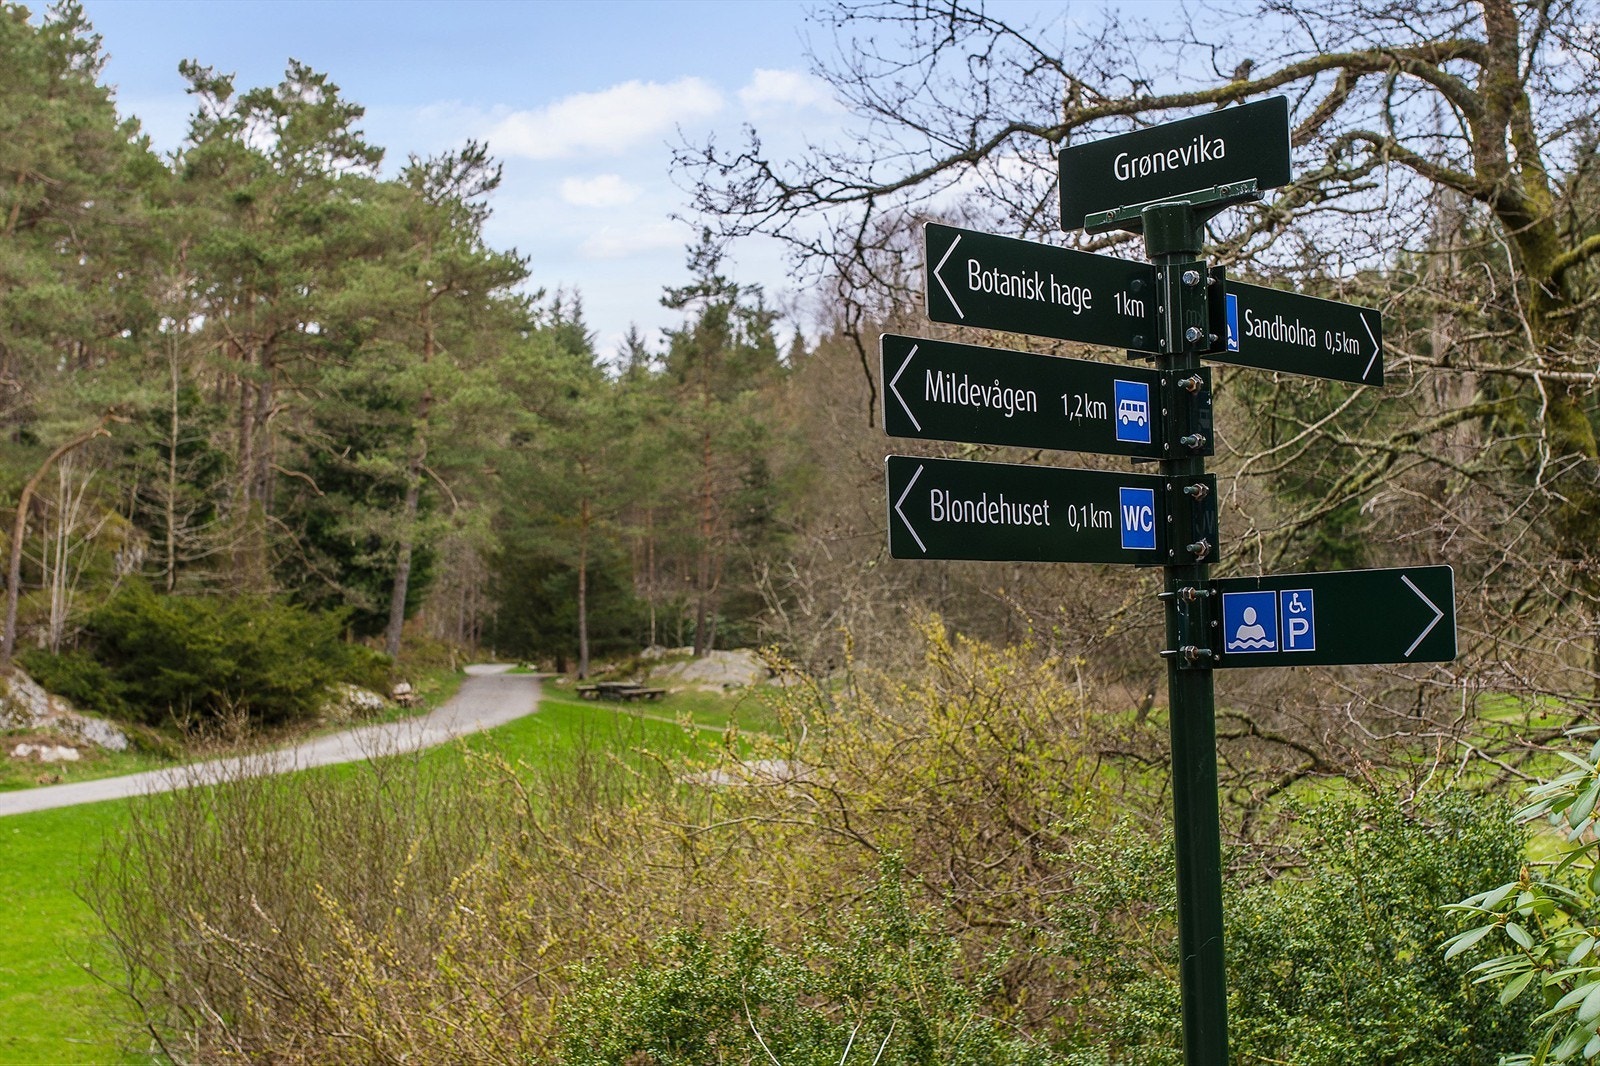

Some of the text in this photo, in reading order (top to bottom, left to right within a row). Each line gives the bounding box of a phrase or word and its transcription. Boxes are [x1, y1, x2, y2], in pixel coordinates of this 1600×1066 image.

[1113, 134, 1226, 182] Grønevika
[967, 258, 1046, 302] Botanisk
[1050, 273, 1093, 316] hage
[1244, 308, 1317, 348] Sandholna
[925, 369, 1038, 418] Mildevågen
[930, 488, 1051, 527] Blondehuset
[1123, 505, 1154, 533] WC
[1287, 617, 1310, 649] P
